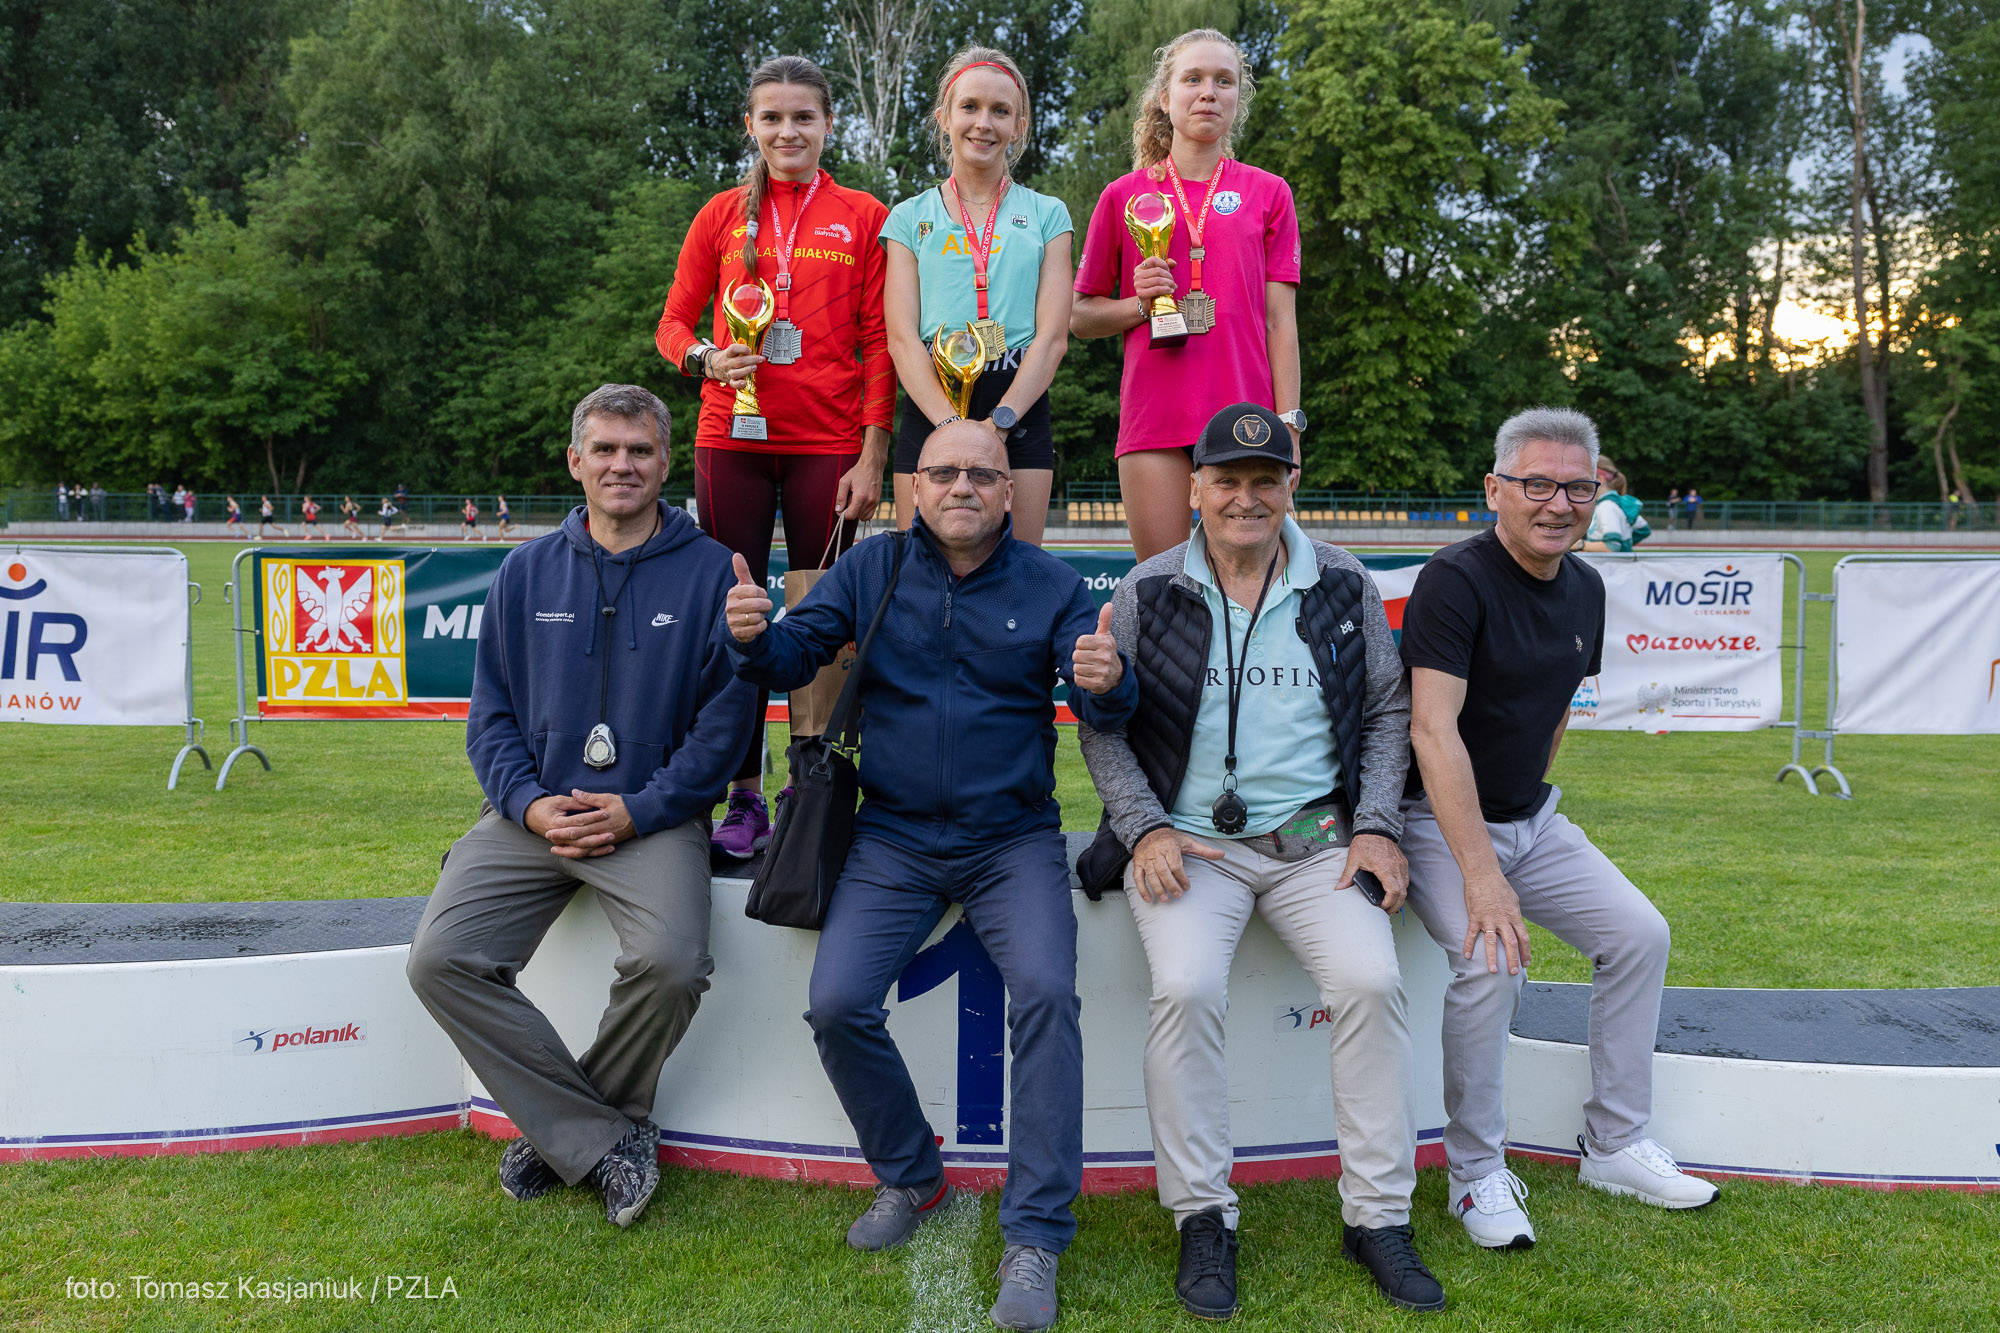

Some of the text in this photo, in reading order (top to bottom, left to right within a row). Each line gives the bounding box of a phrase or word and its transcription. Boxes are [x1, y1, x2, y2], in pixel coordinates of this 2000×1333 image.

[1694, 608, 1752, 616] CIECHANÓW
[273, 658, 399, 698] PZLA
[1674, 686, 1739, 695] Ministerstwo
[1671, 698, 1706, 708] Sportu
[1714, 699, 1761, 709] Turystyki
[1293, 818, 1316, 828] POLAND
[1281, 825, 1317, 836] UNIVERSITY
[1301, 830, 1319, 839] TEAM
[898, 908, 1005, 1146] 1
